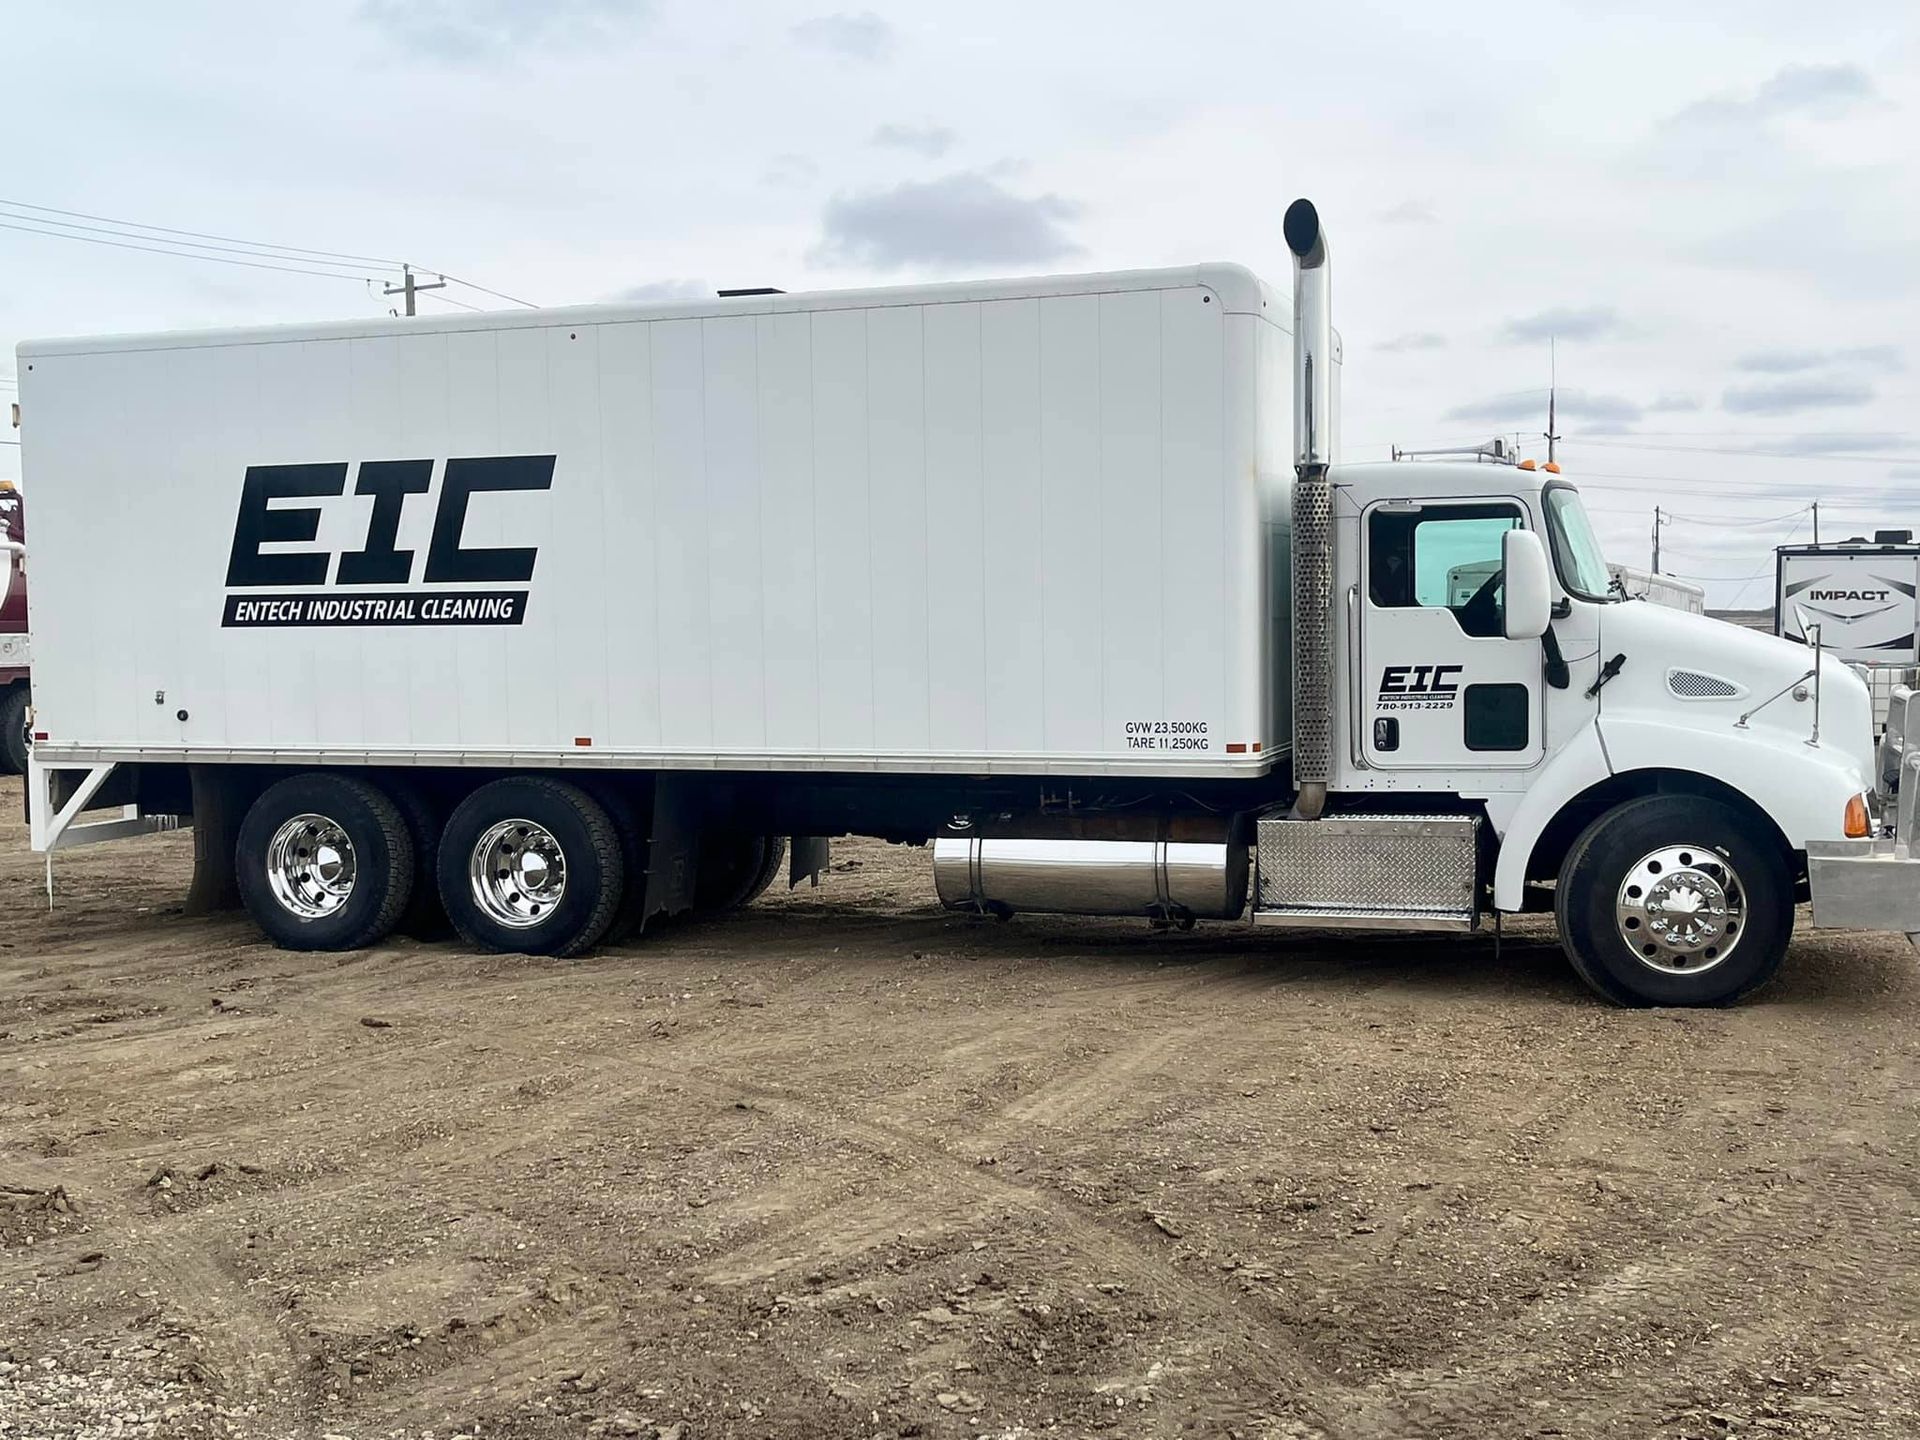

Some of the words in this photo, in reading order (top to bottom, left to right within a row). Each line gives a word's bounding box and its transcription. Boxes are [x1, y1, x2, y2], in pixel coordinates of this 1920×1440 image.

[225, 454, 557, 586] EIC
[1810, 591, 1889, 600] IMPACT
[235, 602, 301, 621] ENTECH
[306, 600, 416, 620] INDUSTRIAL
[421, 599, 514, 619] CLEANING
[1379, 665, 1463, 692] EIC
[1376, 702, 1454, 710] 780-913-2229
[1125, 722, 1152, 733] GVW
[1154, 722, 1207, 734] 23,500KG
[1126, 737, 1156, 748] TARE
[1159, 737, 1208, 750] 11,250KG
